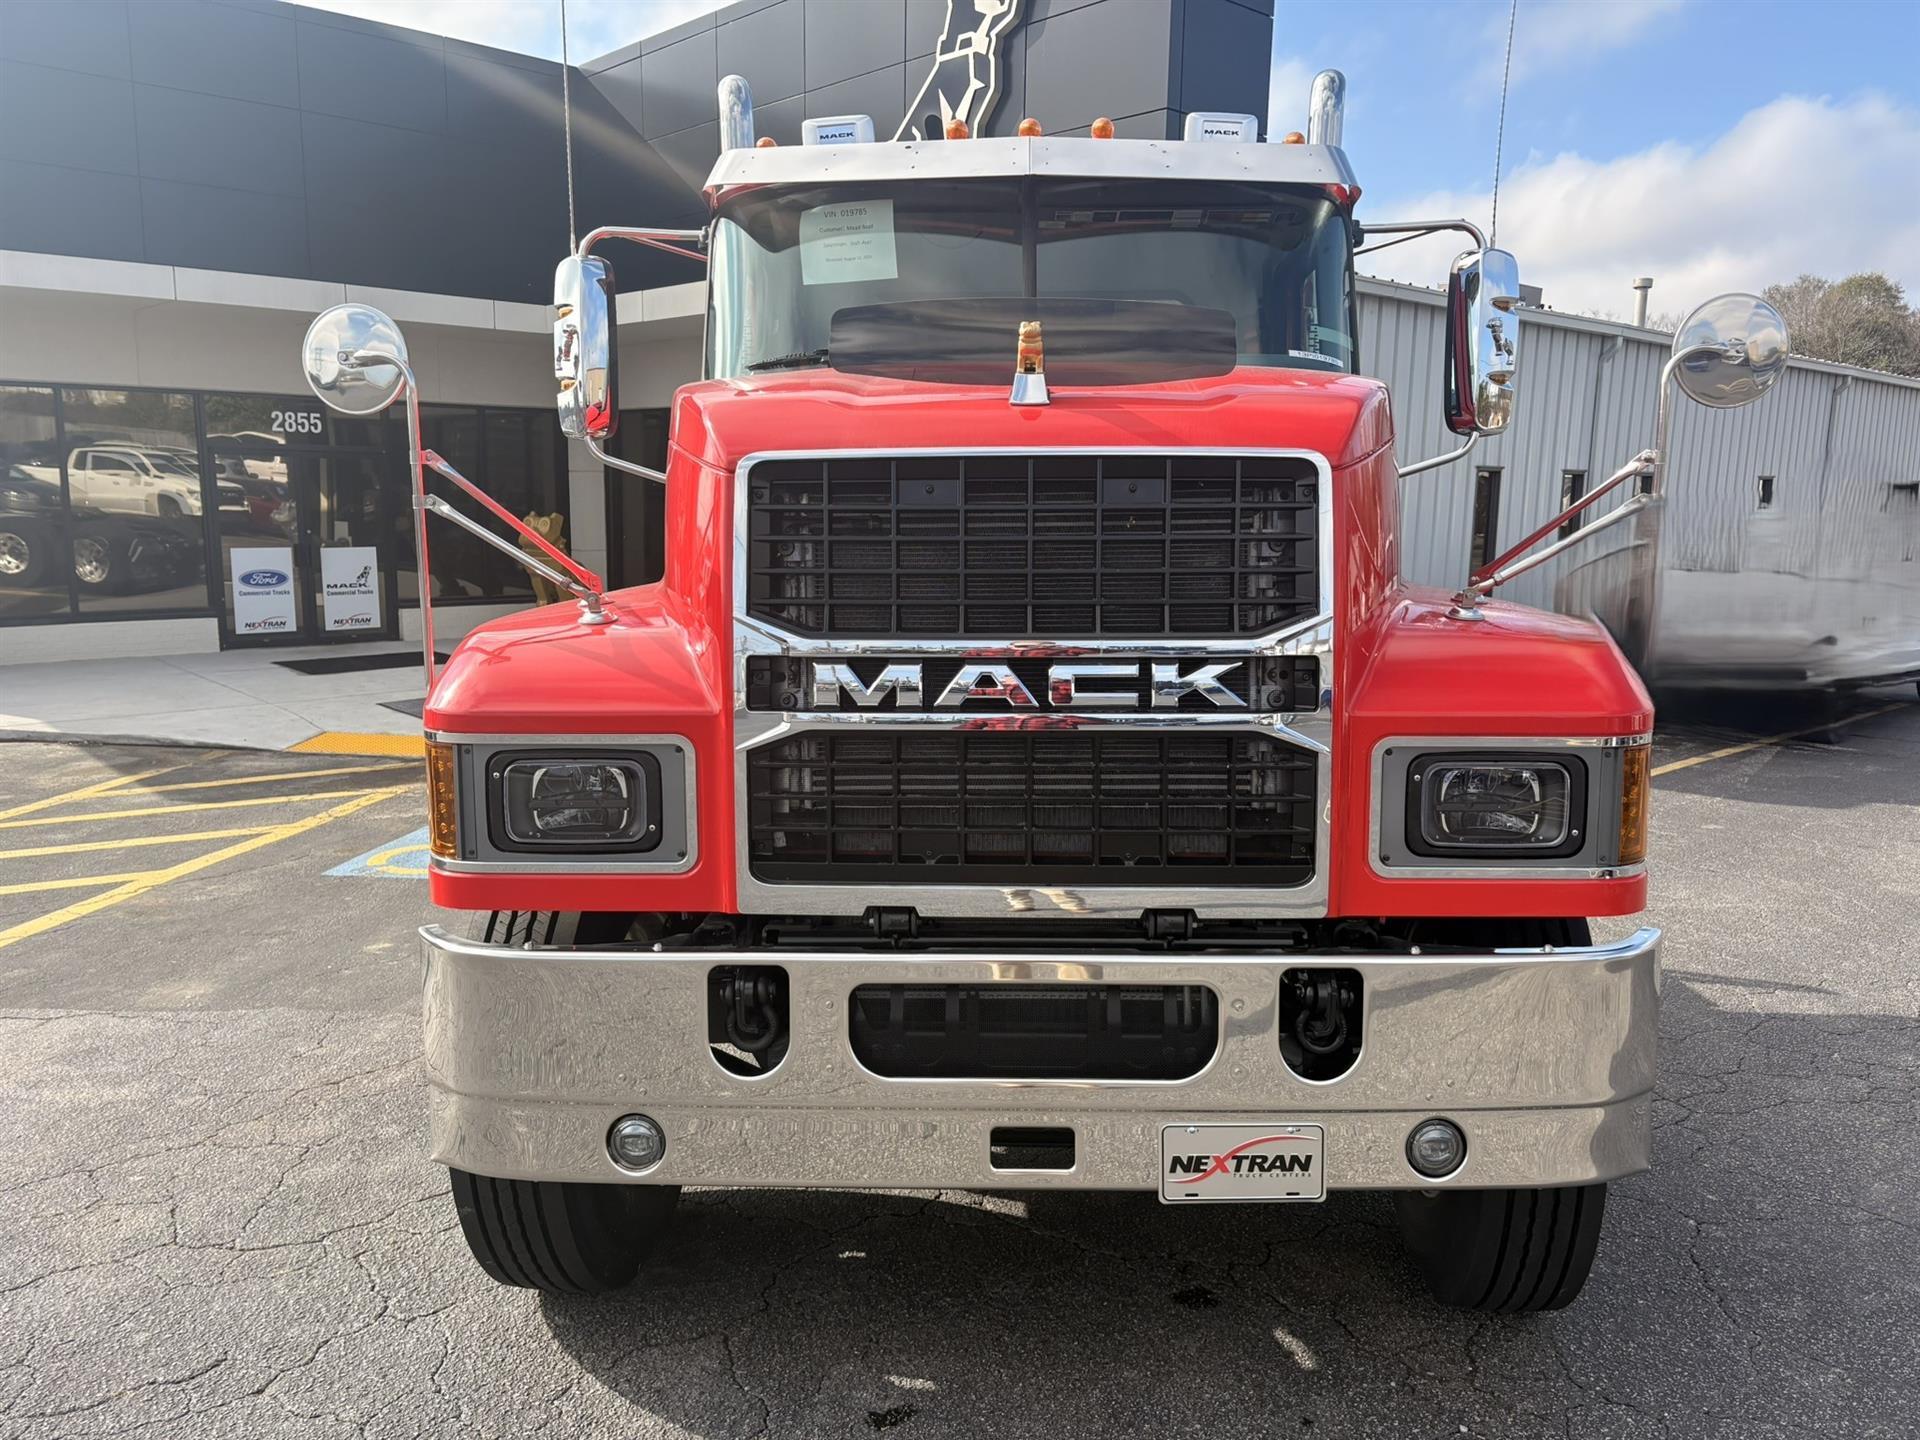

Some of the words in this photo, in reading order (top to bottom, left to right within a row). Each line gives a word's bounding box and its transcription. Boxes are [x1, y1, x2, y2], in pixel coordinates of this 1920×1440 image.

[820, 131, 854, 140] MACK
[271, 411, 322, 434] 2855
[250, 572, 278, 585] Ford
[244, 620, 287, 629] NEXTRAN
[333, 617, 372, 625] NEXTRAN
[812, 660, 1248, 708] MACK
[1168, 1154, 1312, 1174] NEXTRAN
